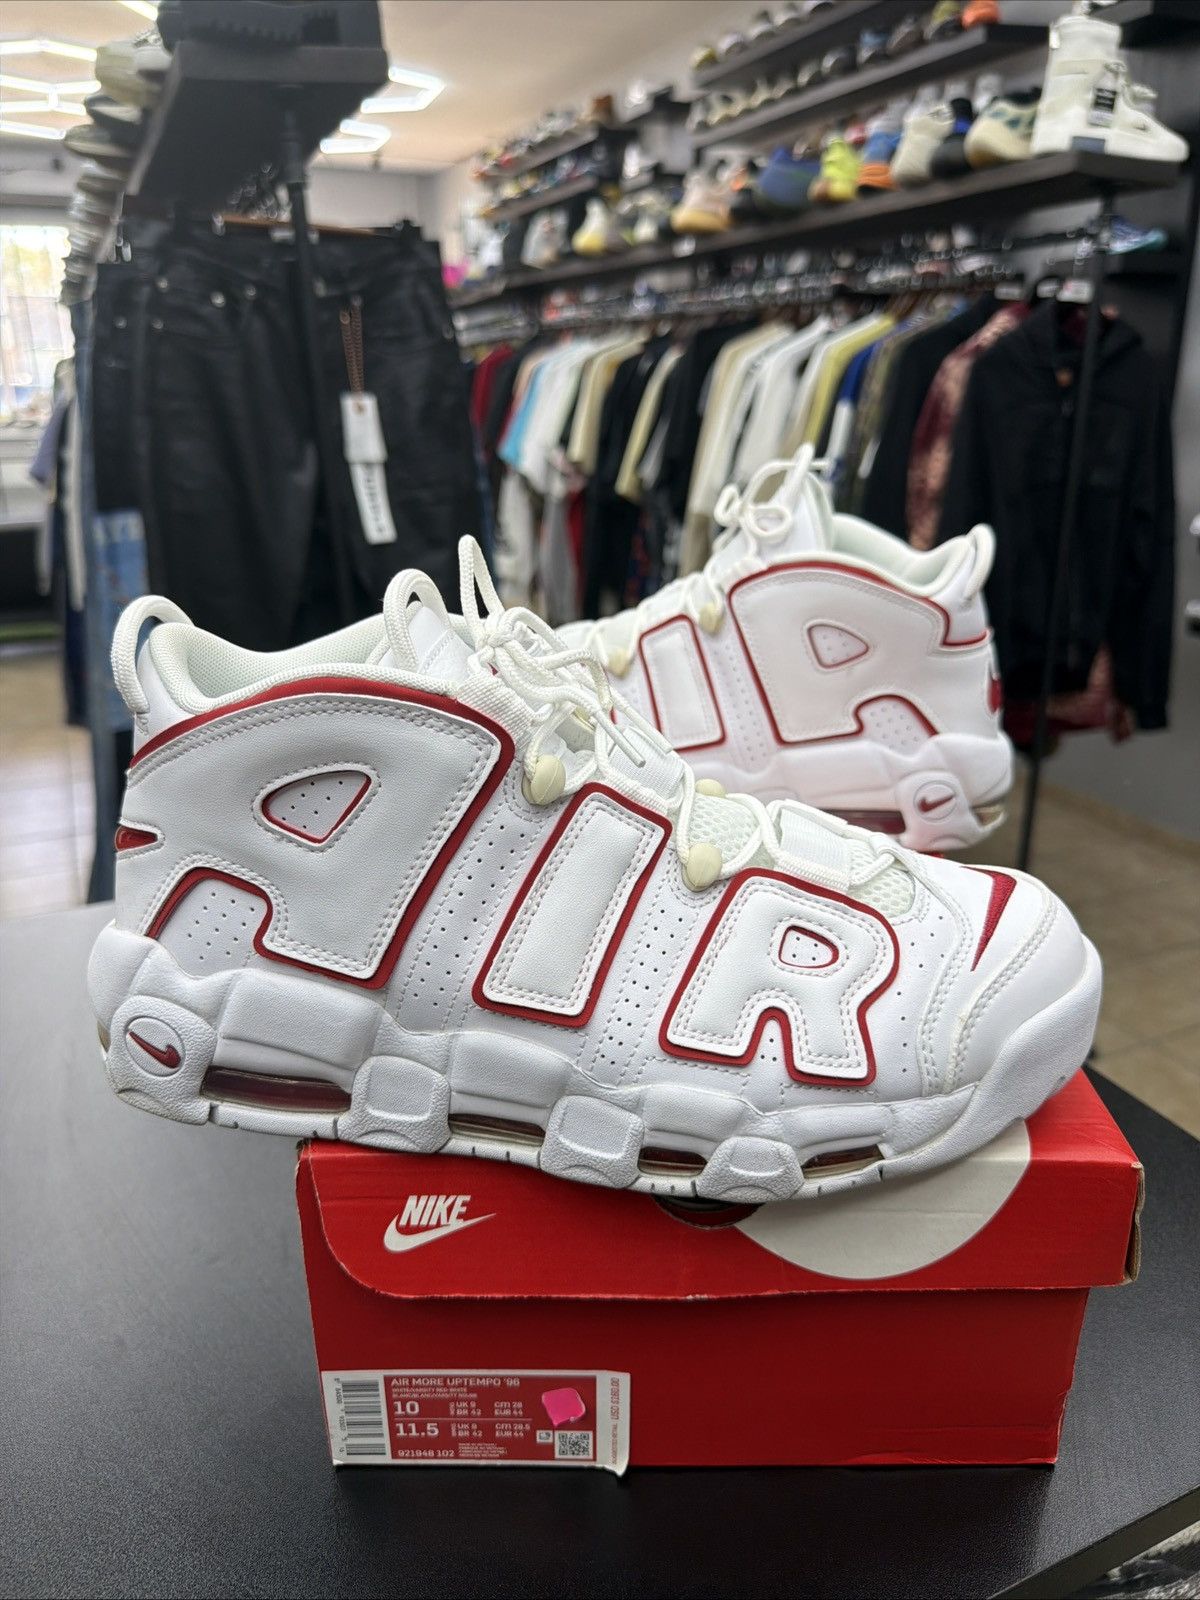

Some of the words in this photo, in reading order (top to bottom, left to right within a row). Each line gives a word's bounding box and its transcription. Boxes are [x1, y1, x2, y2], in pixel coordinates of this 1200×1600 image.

[399, 1195, 471, 1227] NIKE
[391, 1377, 409, 1387] AIR
[412, 1377, 444, 1387] MORE
[446, 1377, 501, 1387] UPTEMPO
[503, 1377, 520, 1388] '96
[393, 1401, 420, 1415] 10
[395, 1422, 439, 1437] 11.5
[398, 1449, 434, 1457] 921948
[436, 1449, 455, 1457] 102
